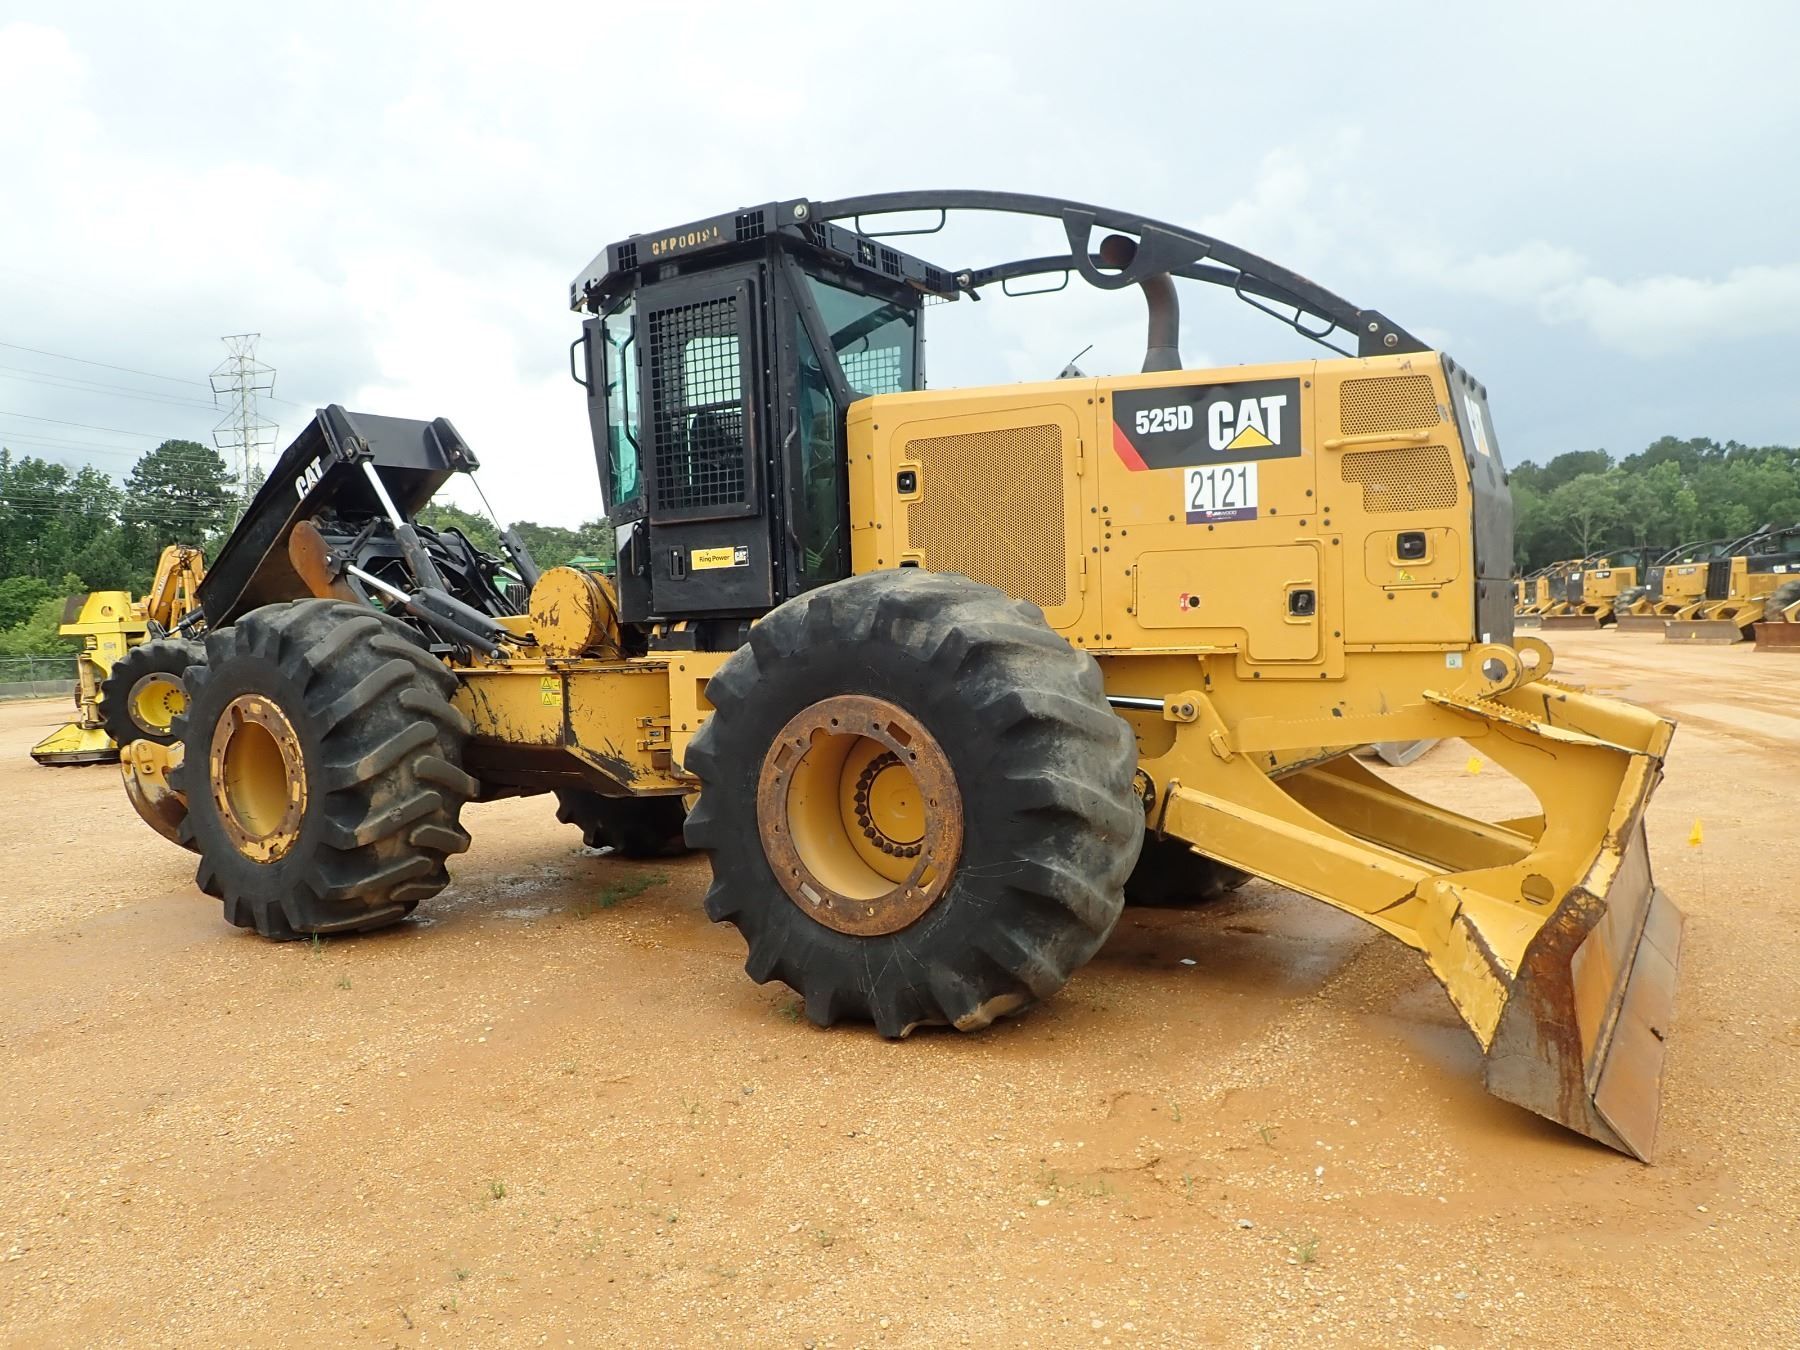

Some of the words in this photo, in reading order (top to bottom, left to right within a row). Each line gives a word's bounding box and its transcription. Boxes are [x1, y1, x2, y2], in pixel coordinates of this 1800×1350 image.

[1135, 405, 1193, 434] 525D
[1208, 395, 1287, 451] CAT
[295, 455, 323, 500] CAT
[1190, 466, 1247, 510] 2121
